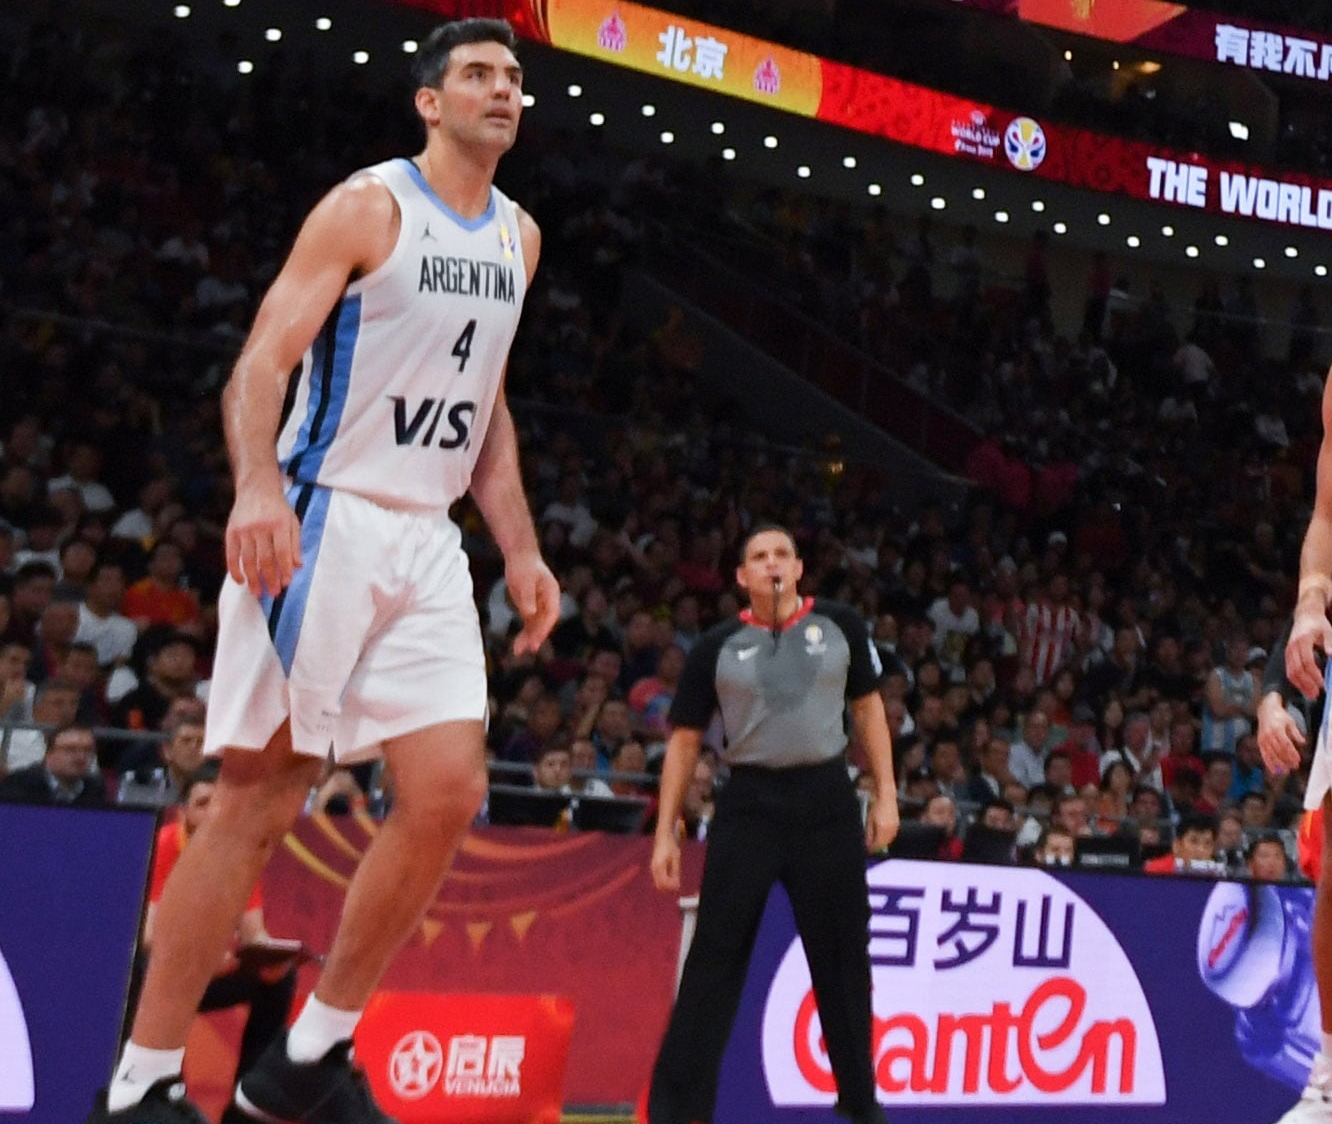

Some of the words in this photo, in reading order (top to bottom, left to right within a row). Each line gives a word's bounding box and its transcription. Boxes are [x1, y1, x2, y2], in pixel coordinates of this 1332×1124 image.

[656, 24, 728, 81] 北京
[1146, 156, 1208, 208] THE
[418, 255, 516, 306] ARGENTINA
[450, 319, 476, 373] 4
[387, 394, 478, 452] VIS
[866, 885, 1076, 971] 百岁山
